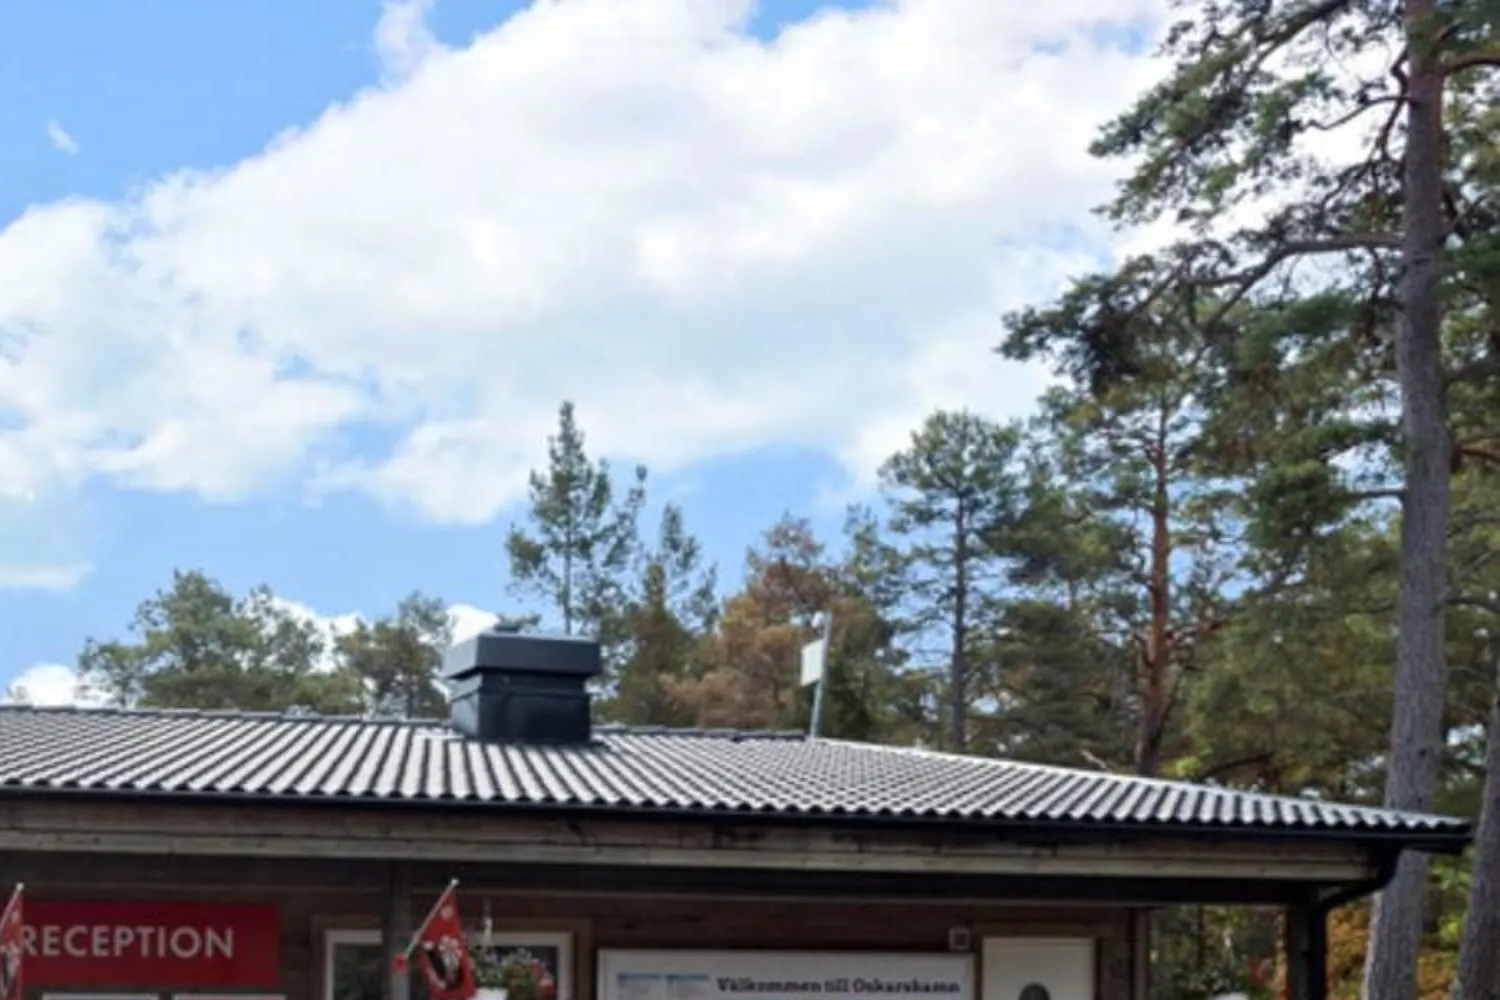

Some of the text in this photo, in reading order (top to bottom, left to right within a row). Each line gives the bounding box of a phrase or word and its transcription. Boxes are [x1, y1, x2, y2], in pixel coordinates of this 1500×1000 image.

[20, 924, 234, 960] RECEPTION
[716, 976, 821, 993] Välkommen
[823, 977, 850, 993] till
[852, 977, 961, 994] Oskarshamn
